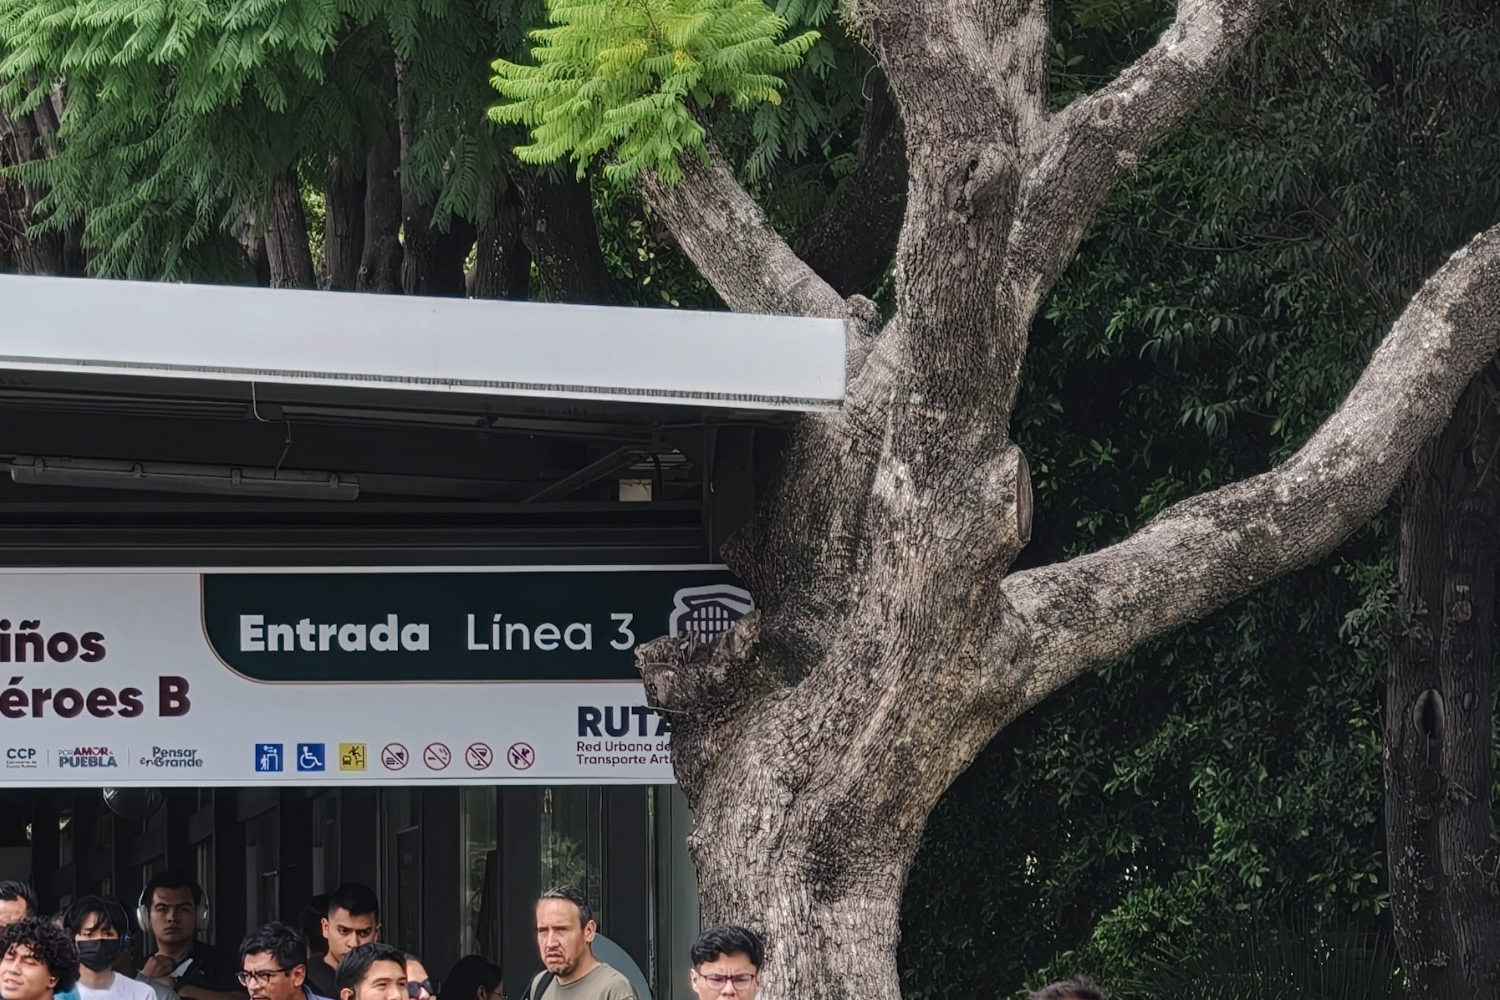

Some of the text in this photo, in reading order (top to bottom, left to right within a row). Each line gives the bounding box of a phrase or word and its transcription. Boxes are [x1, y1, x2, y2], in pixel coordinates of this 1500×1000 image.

[240, 612, 636, 651] Entrada Línea 3
[159, 676, 191, 718] B
[73, 746, 109, 756] AMOR
[152, 746, 198, 758] Pensar
[577, 740, 601, 752] Red
[605, 740, 652, 752] Urbana
[6, 748, 37, 760] CCP
[59, 756, 118, 768] PUEBLA
[576, 754, 646, 767] Transporte
